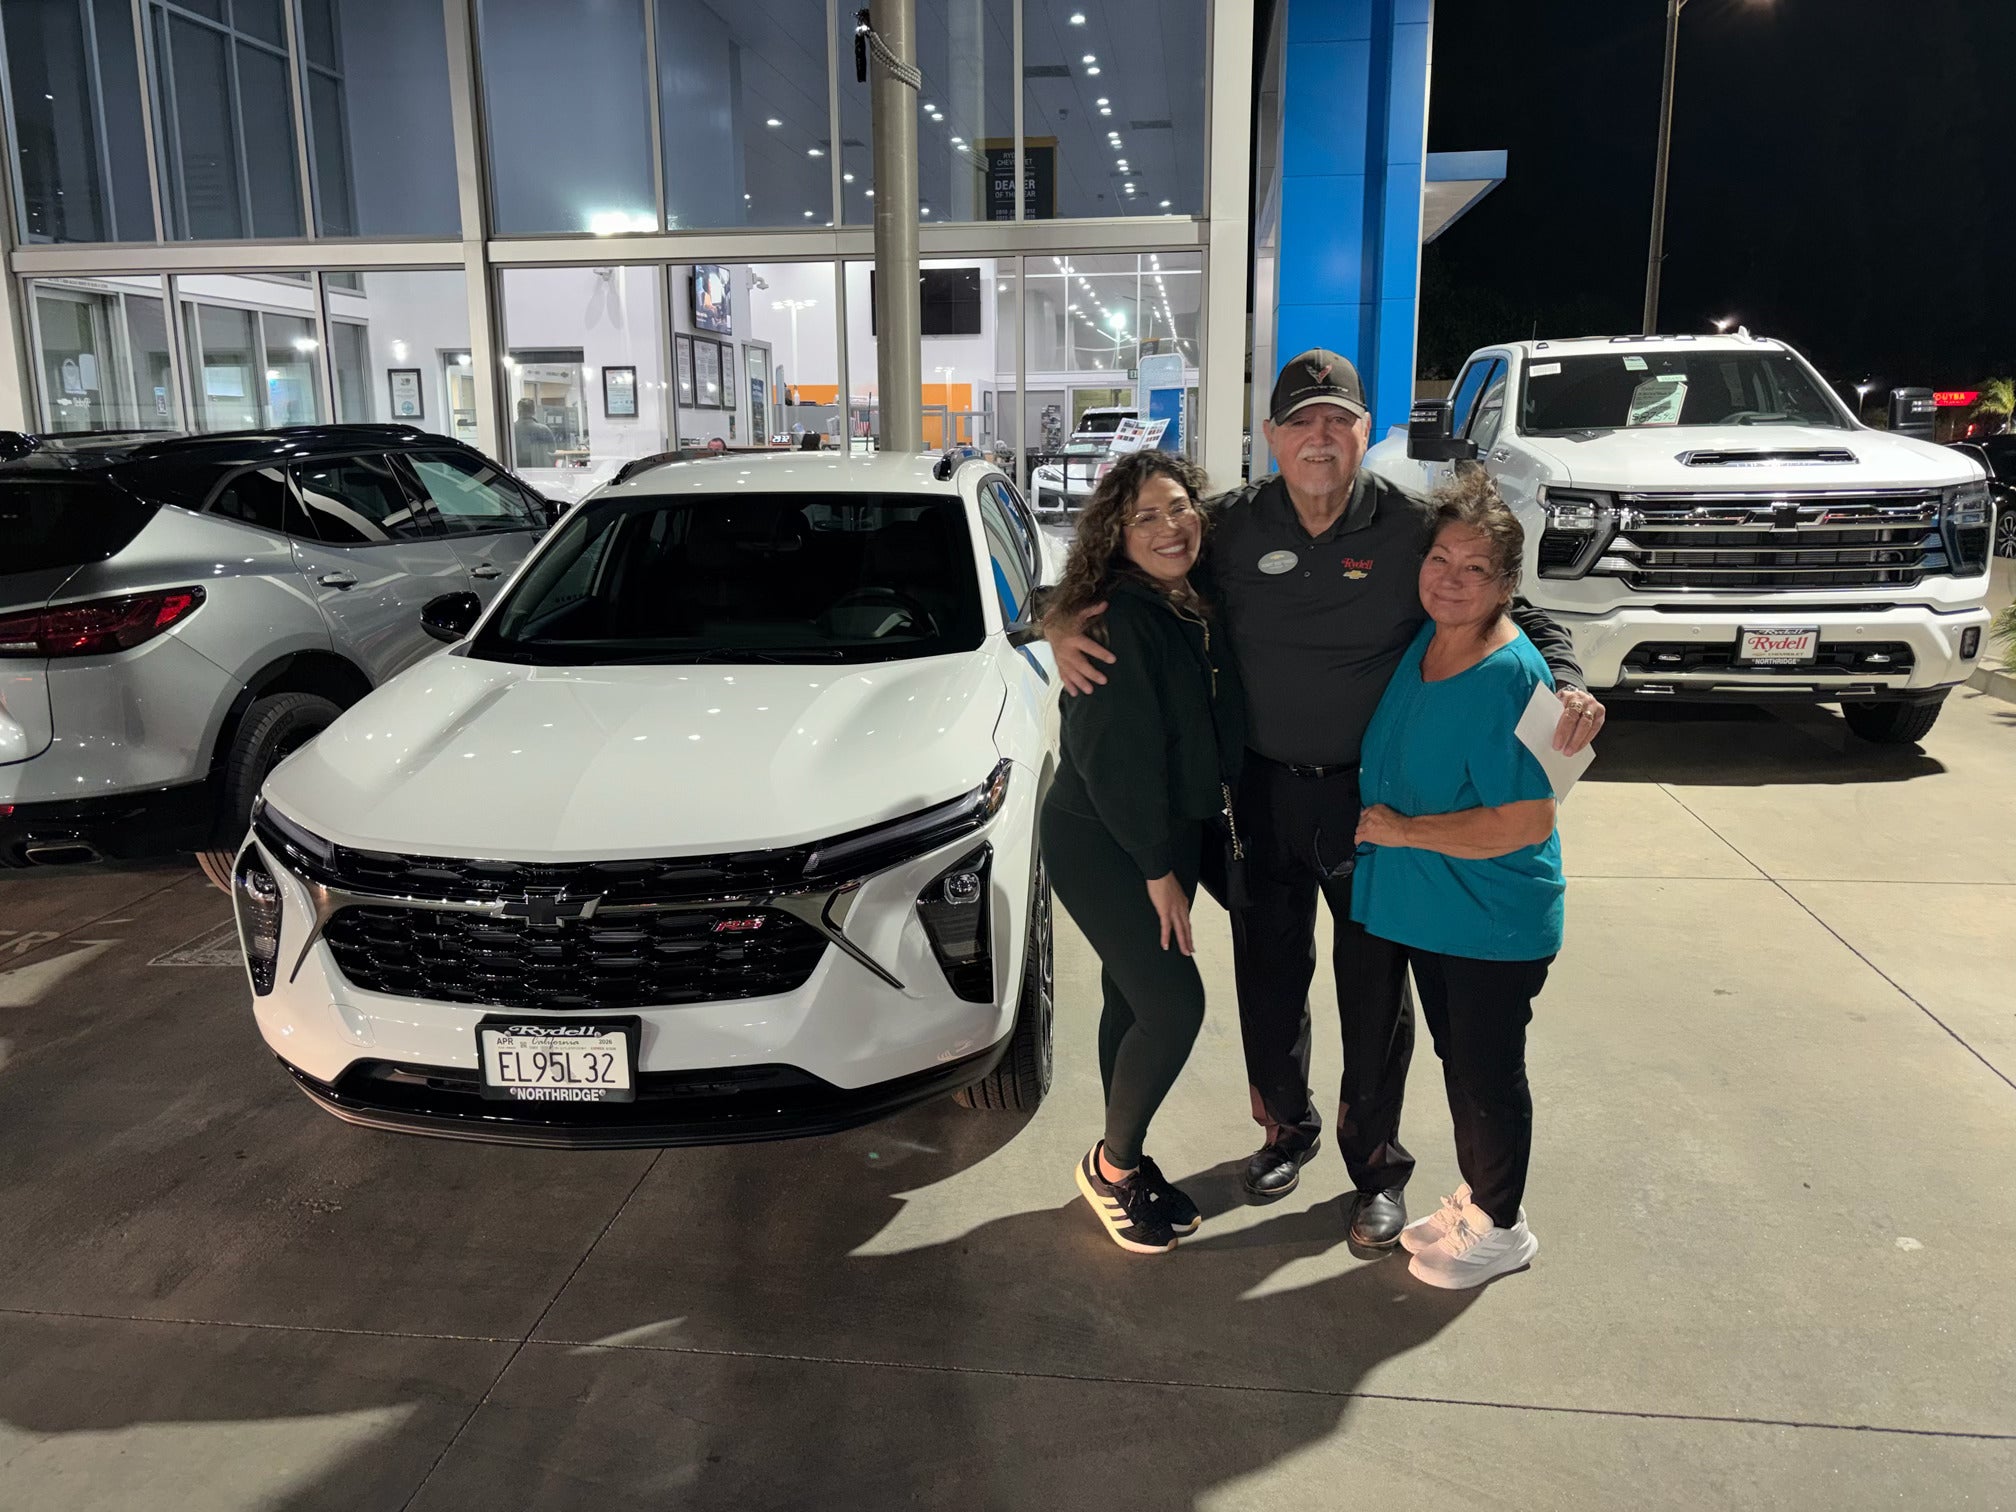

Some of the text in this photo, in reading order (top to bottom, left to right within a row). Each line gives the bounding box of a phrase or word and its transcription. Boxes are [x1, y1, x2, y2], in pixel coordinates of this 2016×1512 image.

[995, 179, 1035, 190] DEAER
[1341, 558, 1374, 570] Rydell
[1748, 636, 1808, 652] Rydell
[508, 1026, 595, 1037] Rydell
[496, 1037, 514, 1046] APR
[531, 1036, 580, 1049] California
[498, 1051, 616, 1083] EL95L32
[517, 1088, 600, 1101] NORTHRIDGE
